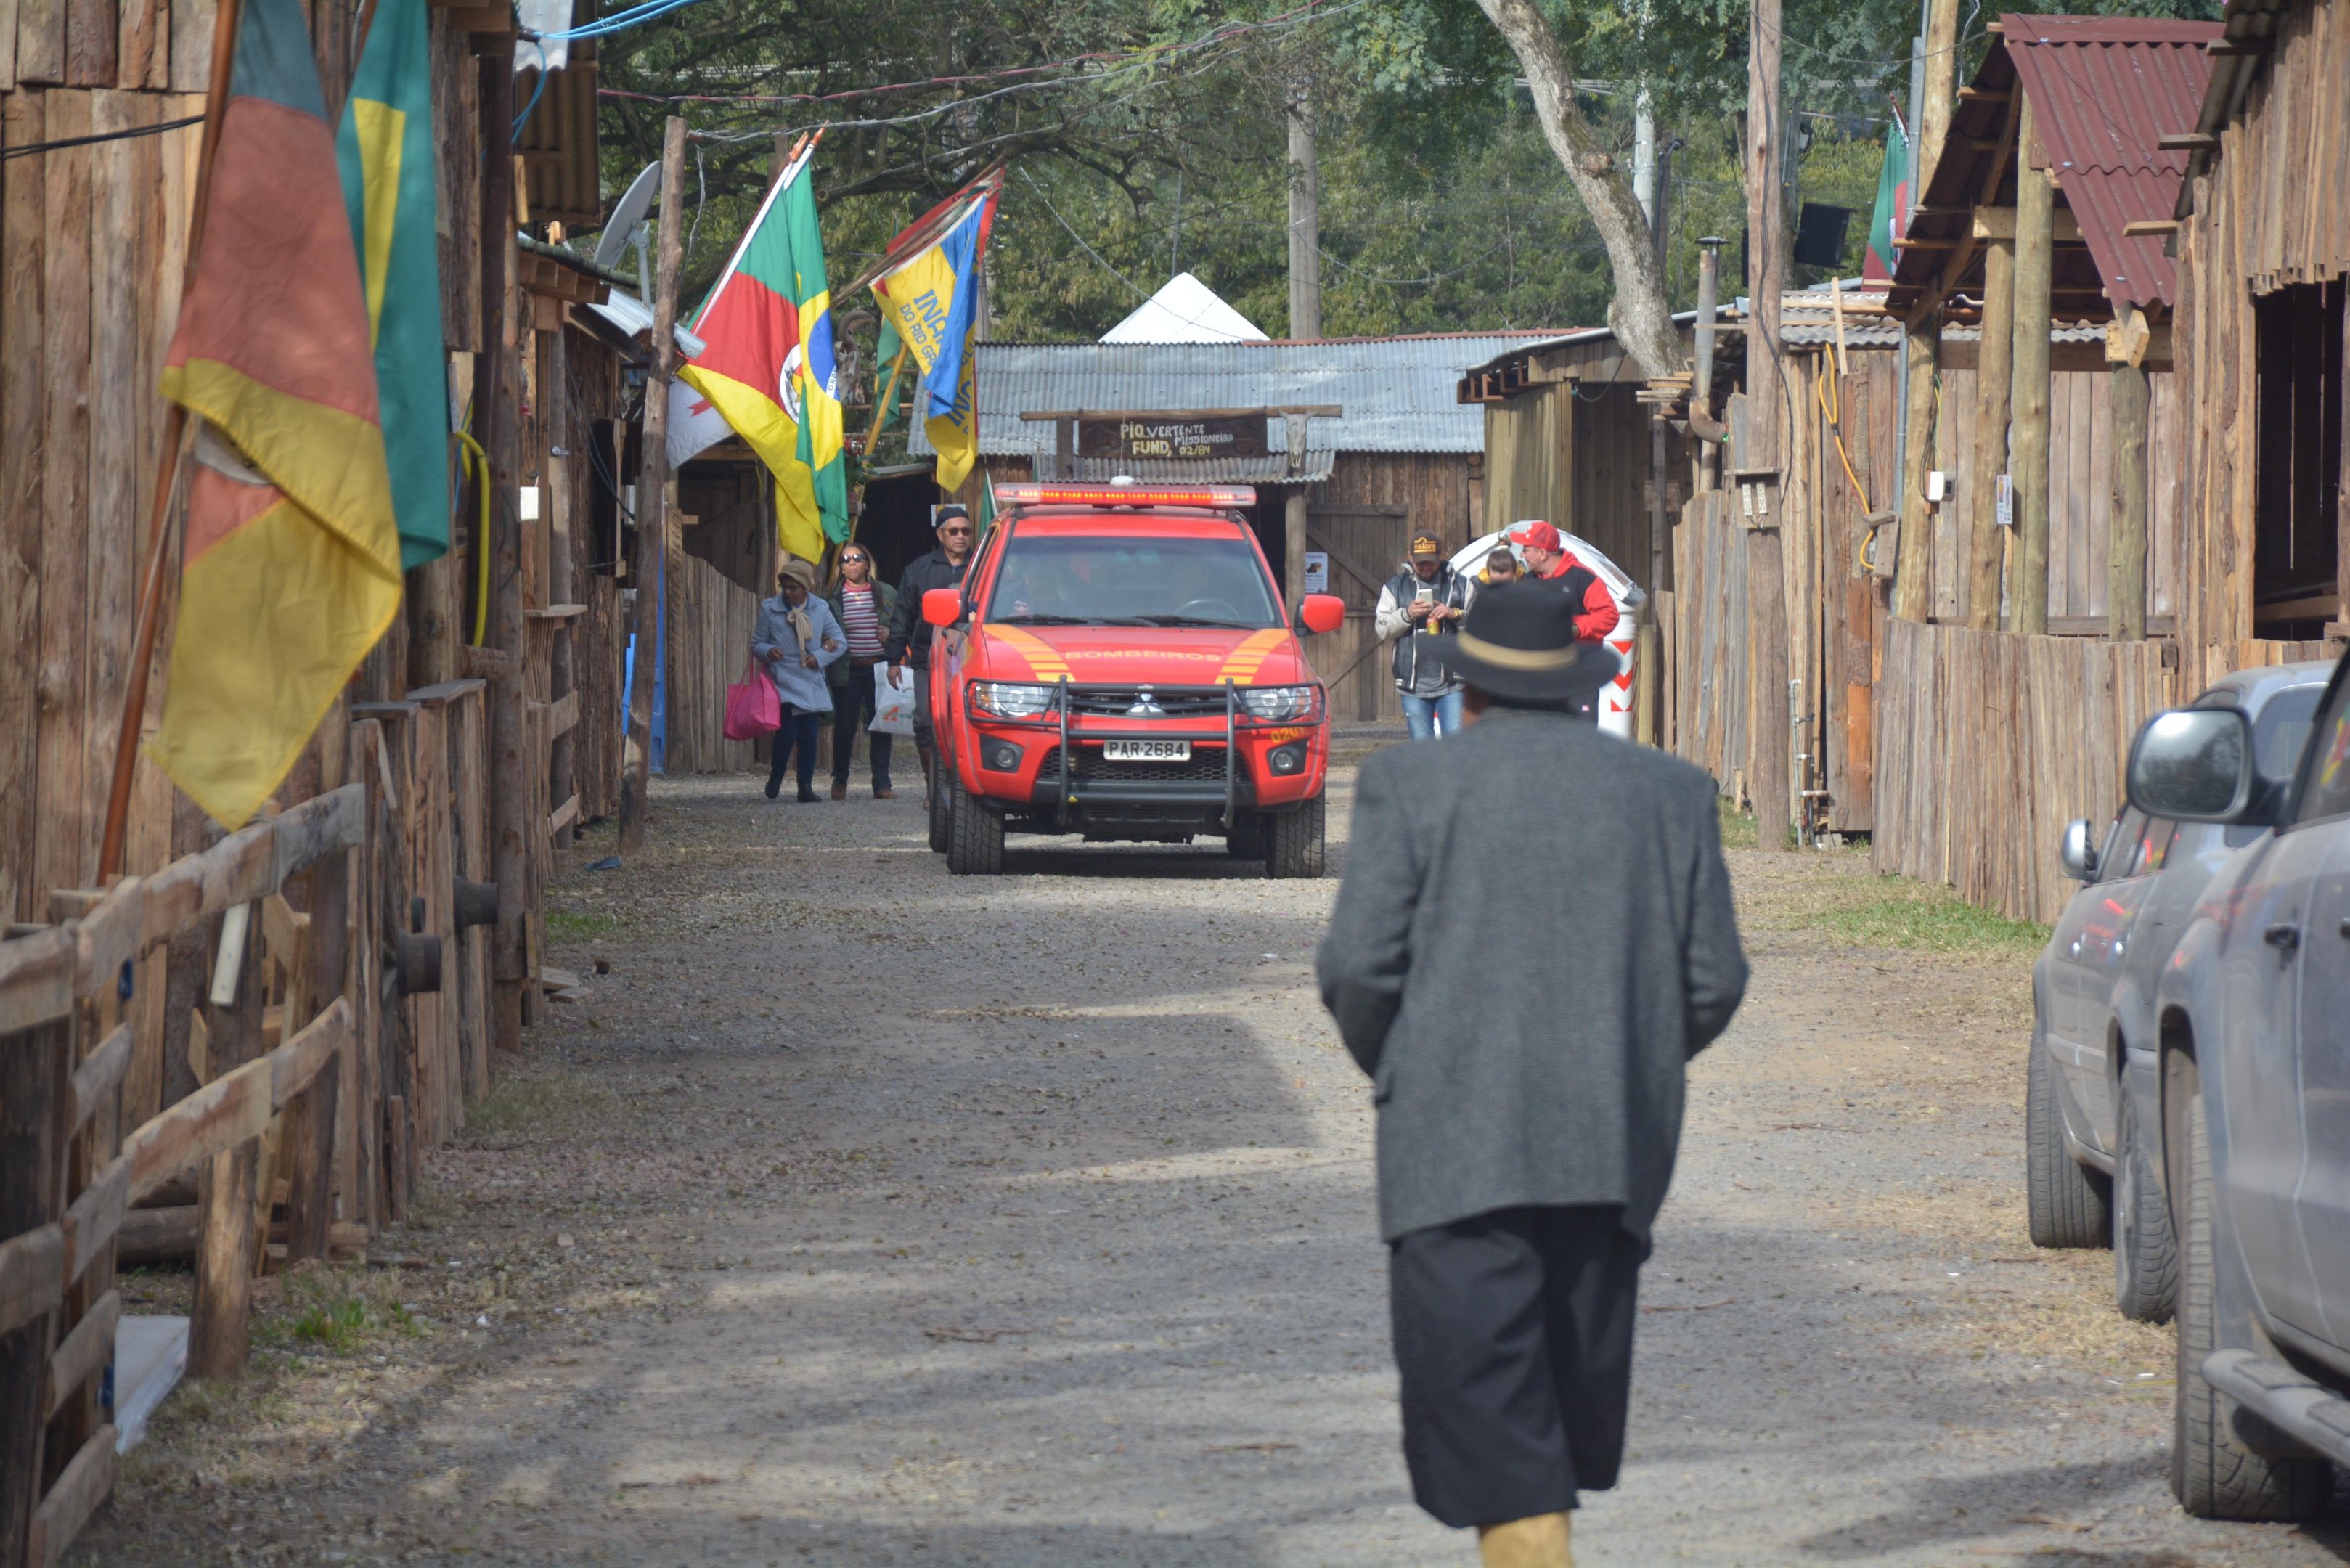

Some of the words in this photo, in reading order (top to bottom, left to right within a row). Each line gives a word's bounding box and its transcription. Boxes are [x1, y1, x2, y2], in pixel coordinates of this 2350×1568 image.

[899, 303, 915, 322] DO
[909, 322, 927, 344] RIO
[921, 345, 939, 367] GR
[1146, 424, 1204, 438] VERTENTE
[1179, 444, 1211, 455] 02/84
[1065, 650, 1221, 662] BOMBEIROS
